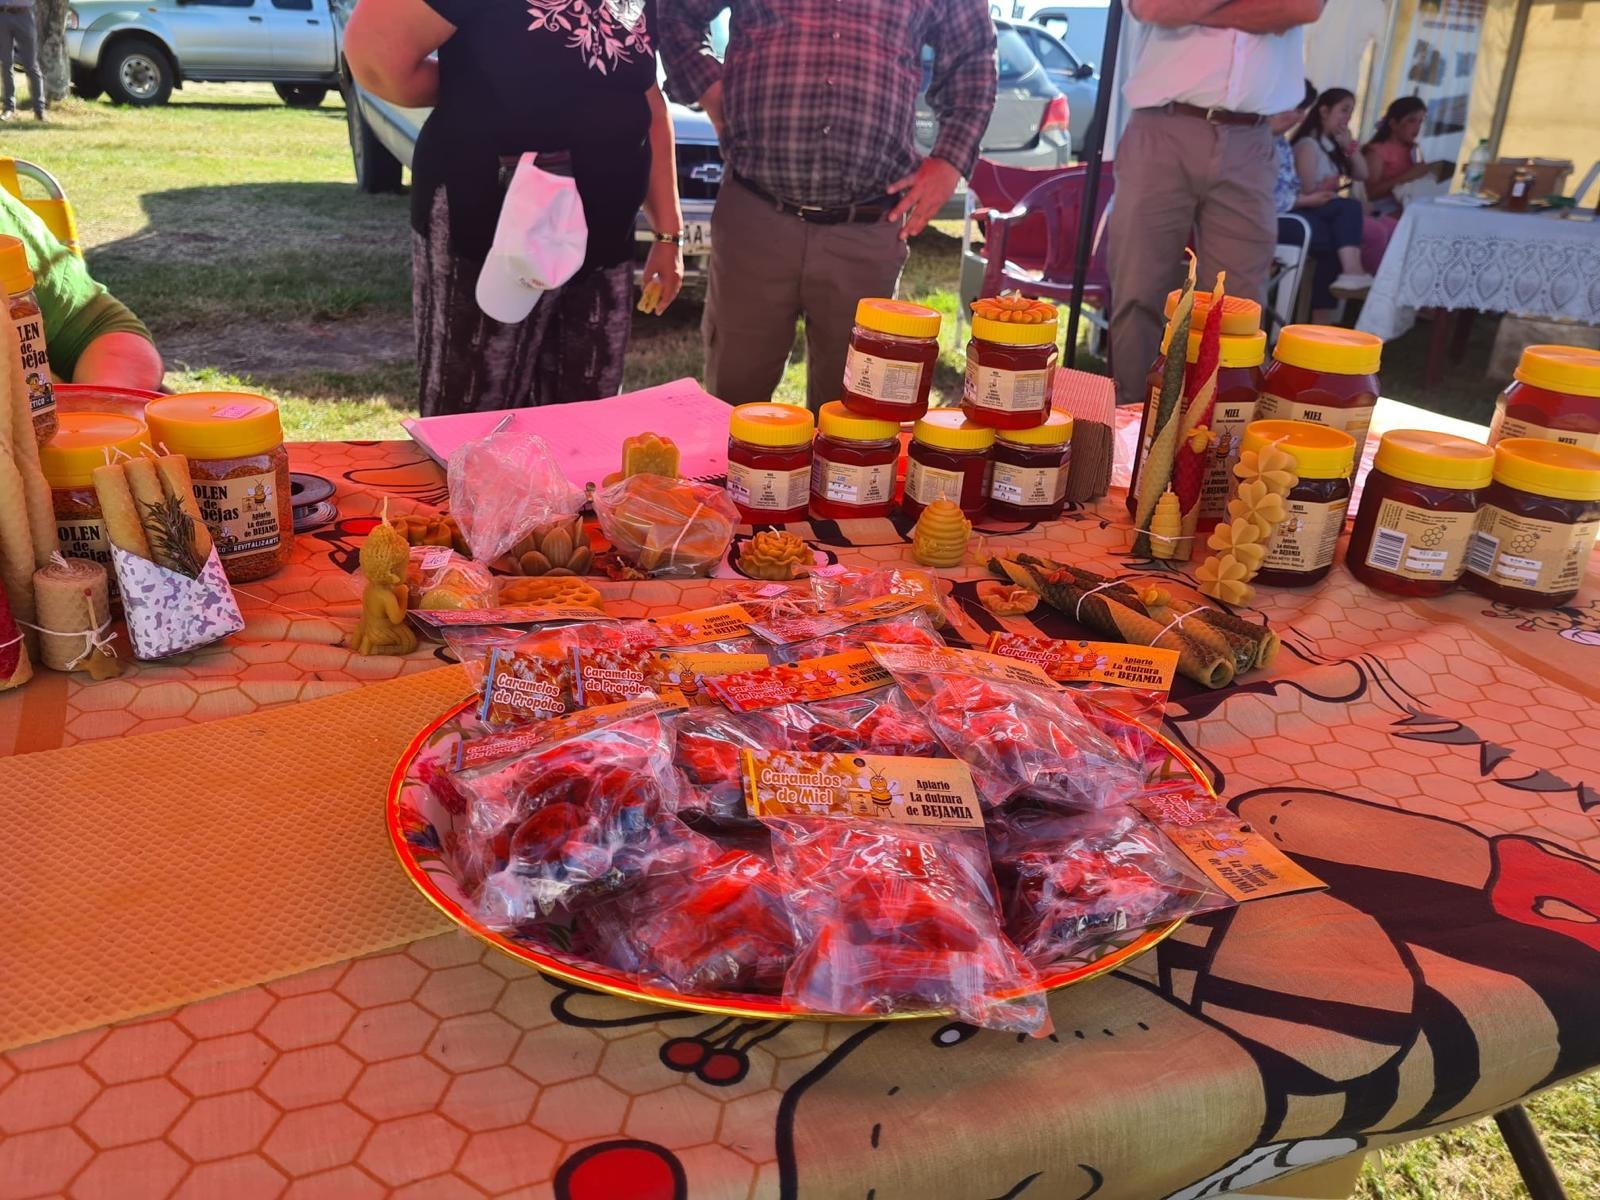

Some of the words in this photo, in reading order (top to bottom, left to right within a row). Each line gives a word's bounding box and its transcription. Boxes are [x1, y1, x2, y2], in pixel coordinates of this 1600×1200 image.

[20, 342, 33, 355] de
[203, 500, 218, 510] de
[73, 541, 90, 552] de
[997, 643, 1061, 662] Caramelos
[1123, 656, 1154, 666] Apiario
[583, 666, 644, 682] Caramelos
[1112, 662, 1124, 670] La
[1125, 664, 1159, 675] dulzura
[1103, 669, 1116, 678] de
[1117, 671, 1163, 685] BEJAMIA
[496, 672, 560, 697] Caramelos
[585, 678, 601, 691] de
[493, 690, 511, 704] de
[511, 690, 566, 714] Propóleo
[761, 768, 842, 788] Caramelos
[916, 779, 951, 791] Apiario
[776, 787, 797, 803] de
[799, 788, 834, 805] Miel
[909, 791, 922, 803] La
[924, 793, 963, 804] dulzura
[906, 805, 919, 816] de
[921, 804, 974, 819] BEJAMIA
